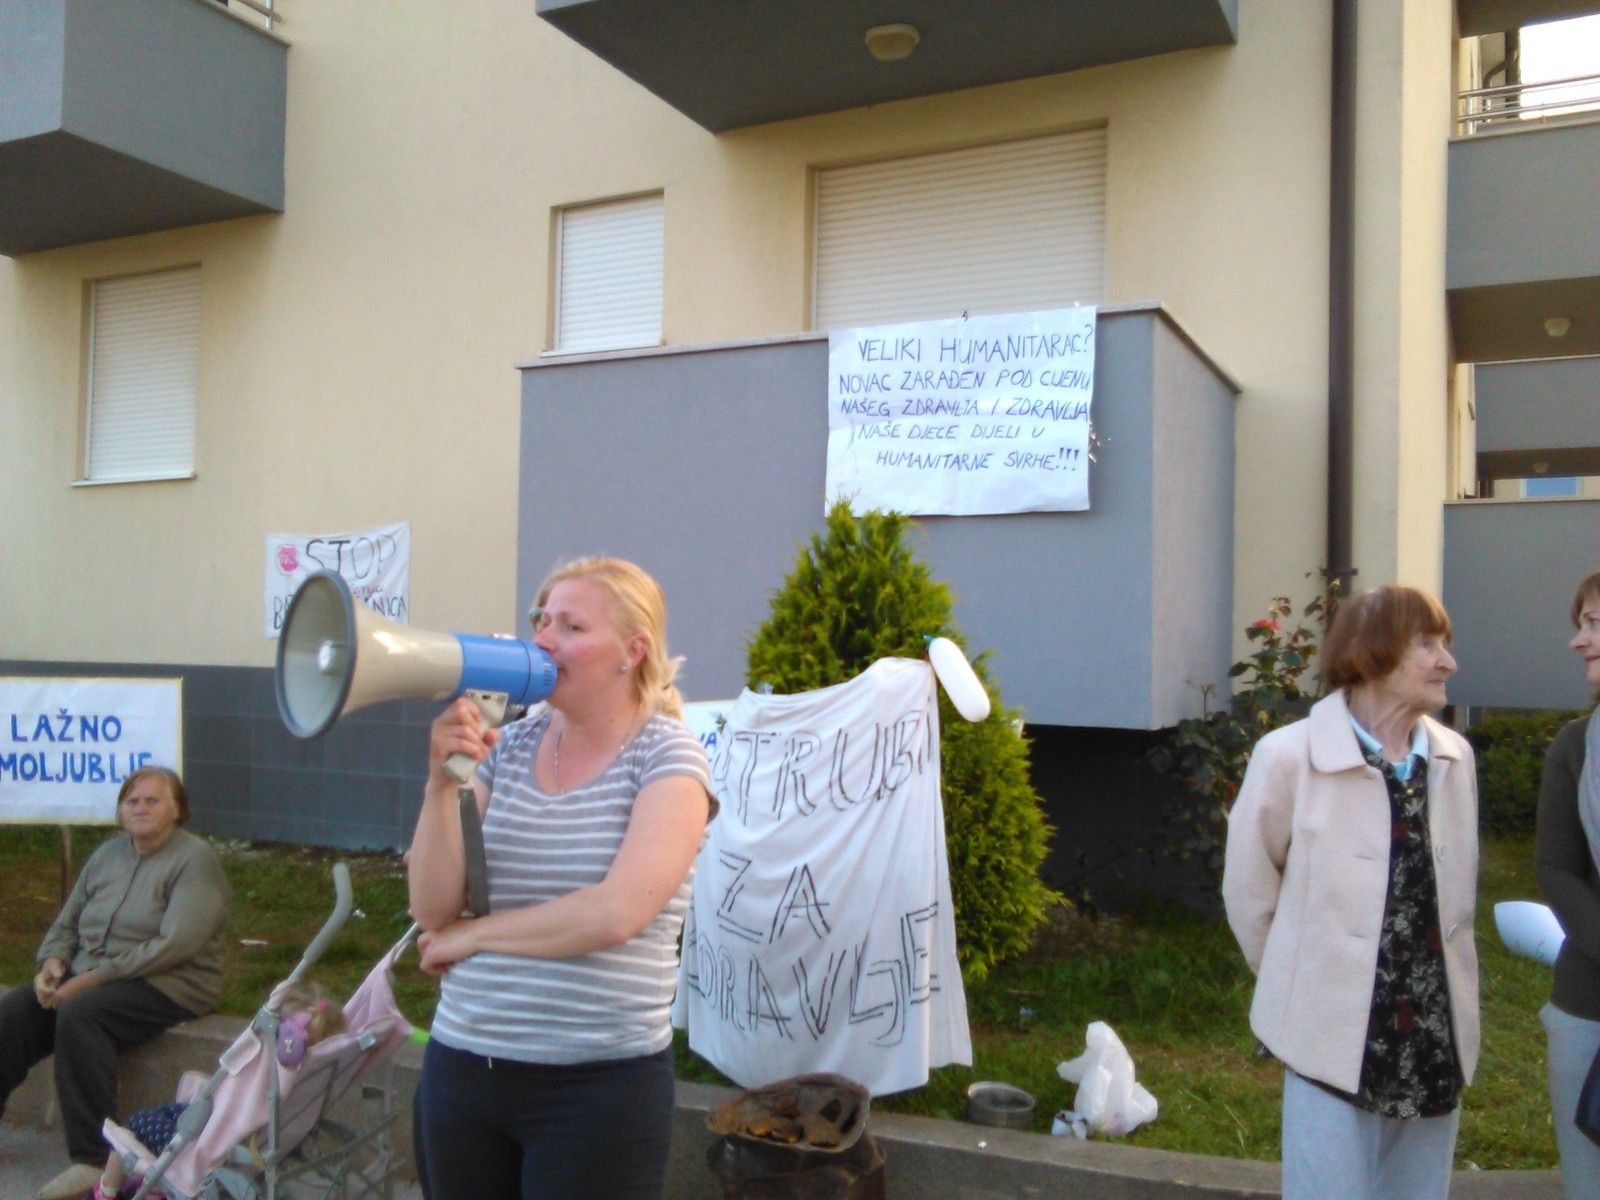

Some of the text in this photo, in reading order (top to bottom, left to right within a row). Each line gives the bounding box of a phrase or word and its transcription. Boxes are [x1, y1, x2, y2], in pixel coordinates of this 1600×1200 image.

[858, 323, 1093, 365] VELIKI HUMANITARAC?
[839, 373, 891, 395] NOVAC
[995, 369, 1033, 389] POD
[1040, 370, 1091, 391] CIJENU
[841, 397, 1088, 422] NAŠEG ZDRAVLJA I ZDRAVLJA
[857, 422, 1046, 440] NAŠE DJECE DIJELI U
[876, 446, 1080, 472] HUMANITARNE SVRHE!!!
[305, 534, 397, 580] STOP
[11, 708, 122, 743] LAŽNO
[716, 849, 831, 944] ZA
